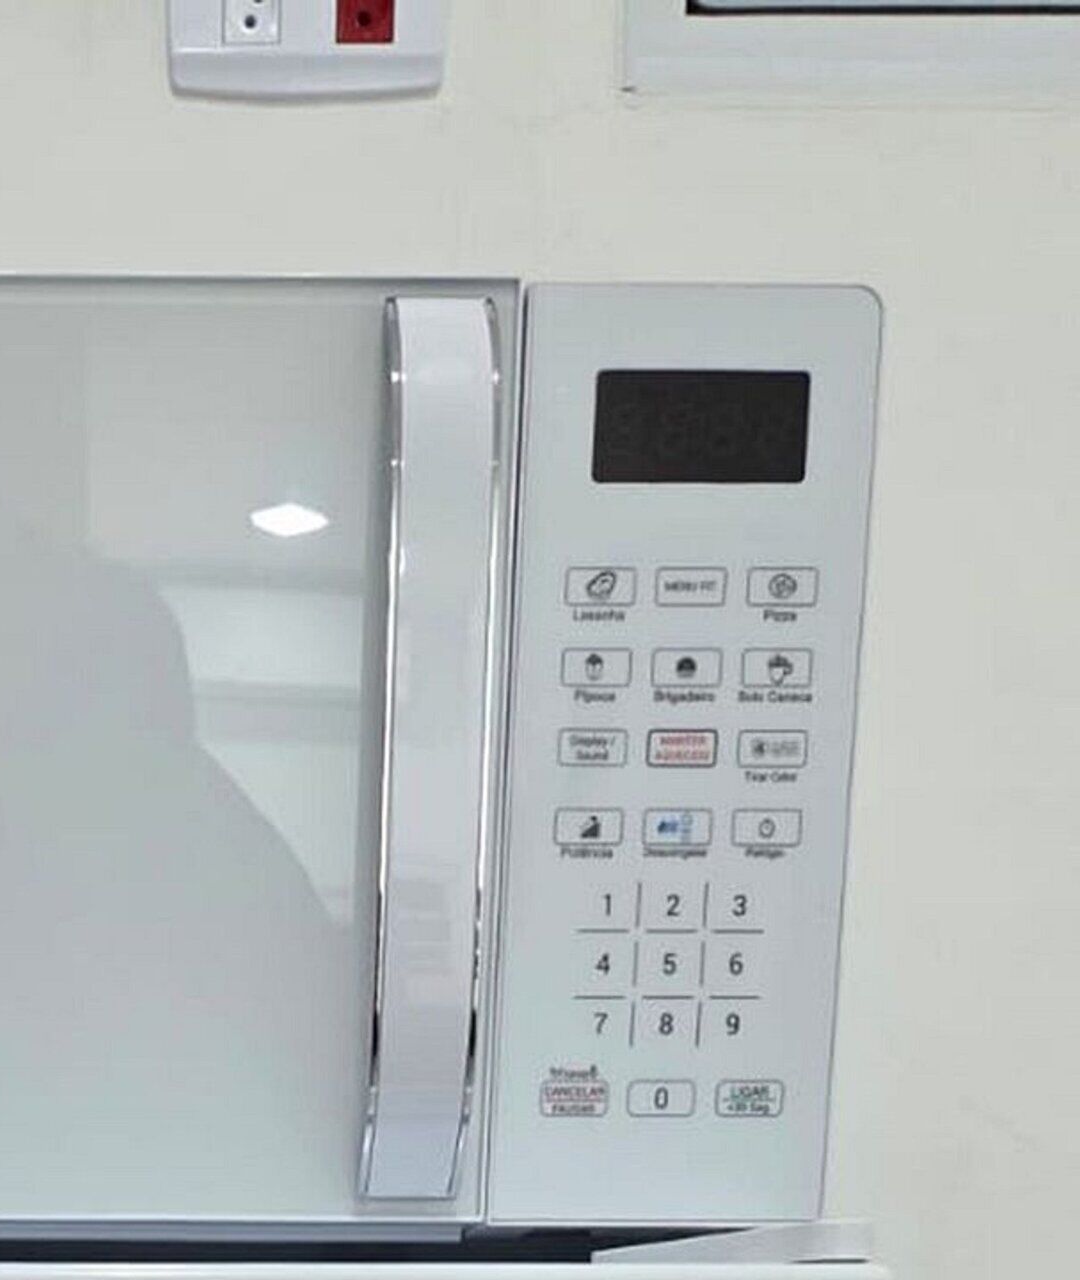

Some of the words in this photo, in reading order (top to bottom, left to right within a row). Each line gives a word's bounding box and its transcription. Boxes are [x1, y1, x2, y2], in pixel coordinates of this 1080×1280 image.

[602, 893, 612, 917] 1
[665, 893, 681, 918] 2
[731, 894, 748, 918] 3
[595, 953, 612, 975] 4
[662, 953, 678, 976] 5
[728, 953, 744, 976] 6
[593, 1012, 608, 1035] 7
[658, 1012, 674, 1036] 8
[725, 1012, 741, 1036] 9
[653, 1087, 669, 1110] 0
